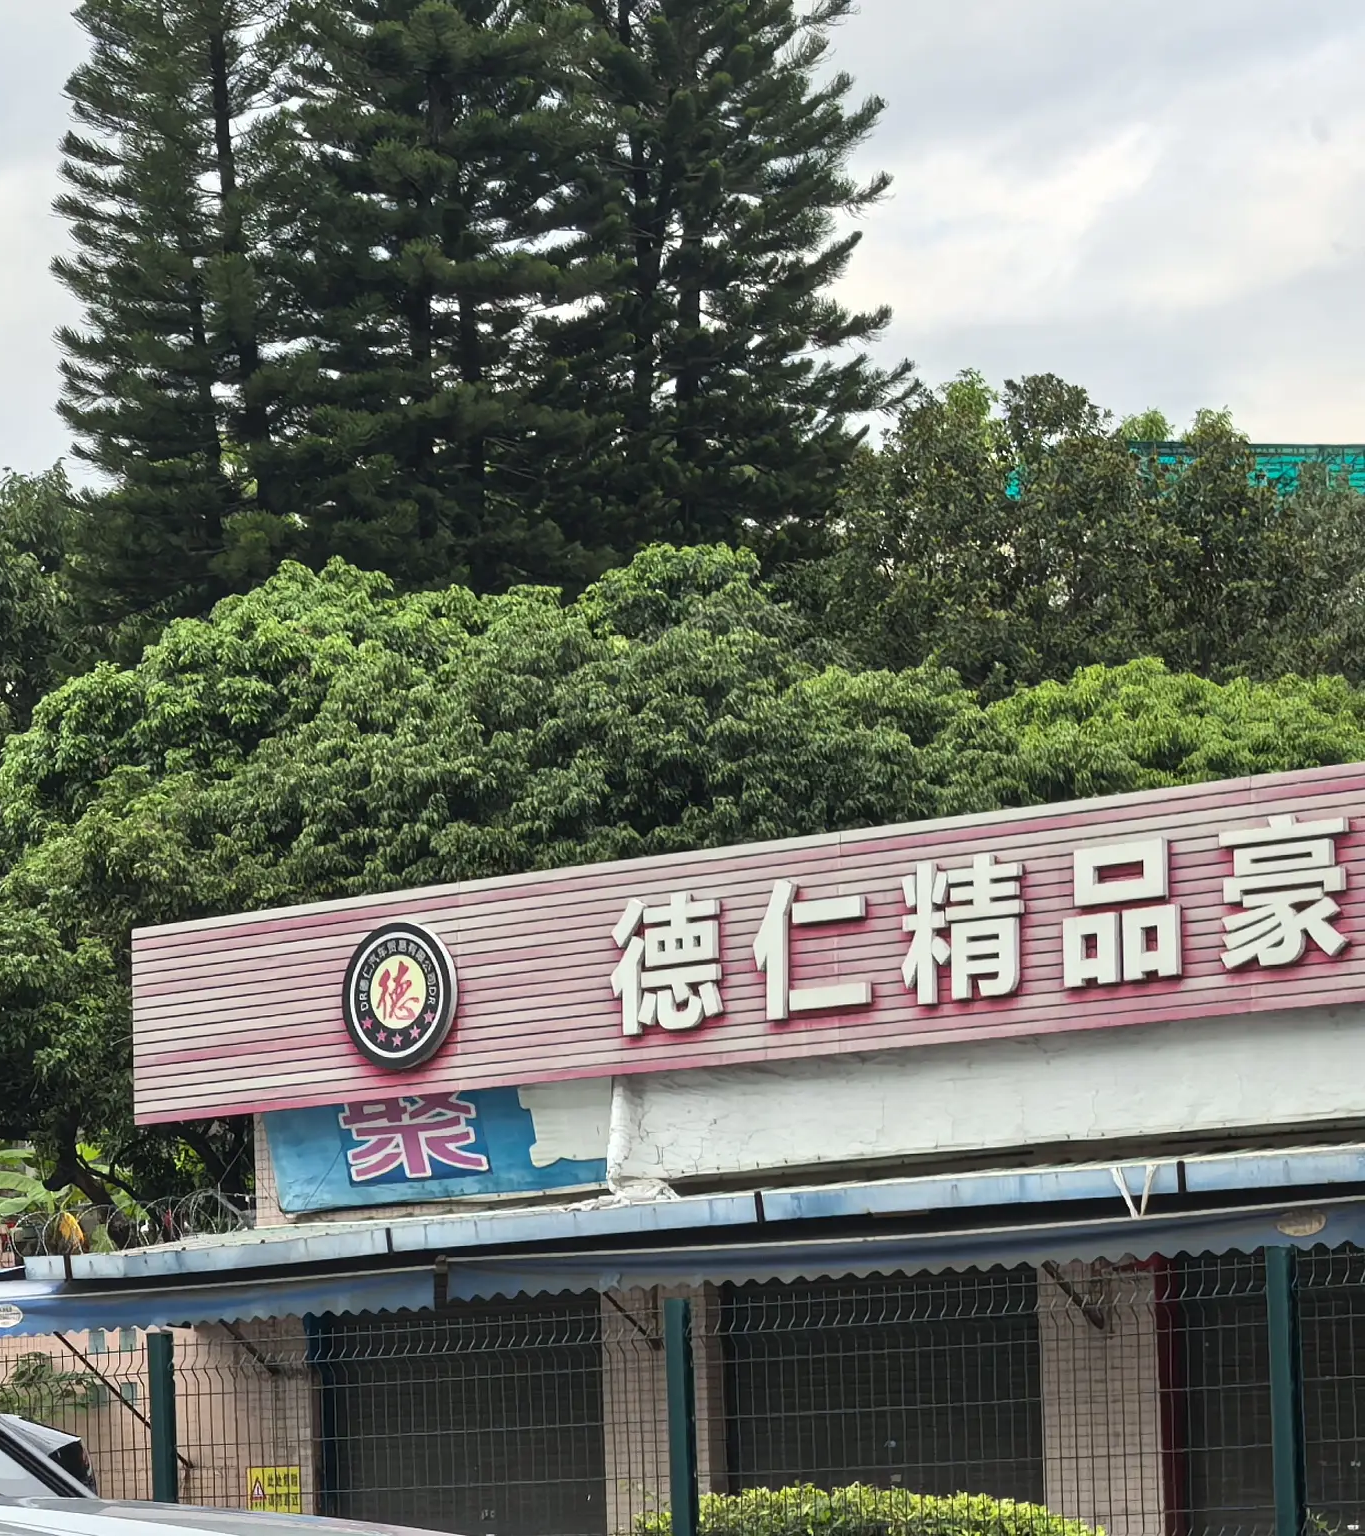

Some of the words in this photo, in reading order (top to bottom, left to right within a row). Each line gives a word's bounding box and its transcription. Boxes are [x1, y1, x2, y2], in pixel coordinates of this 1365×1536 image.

[610, 815, 1351, 1036] 德仁精品豪
